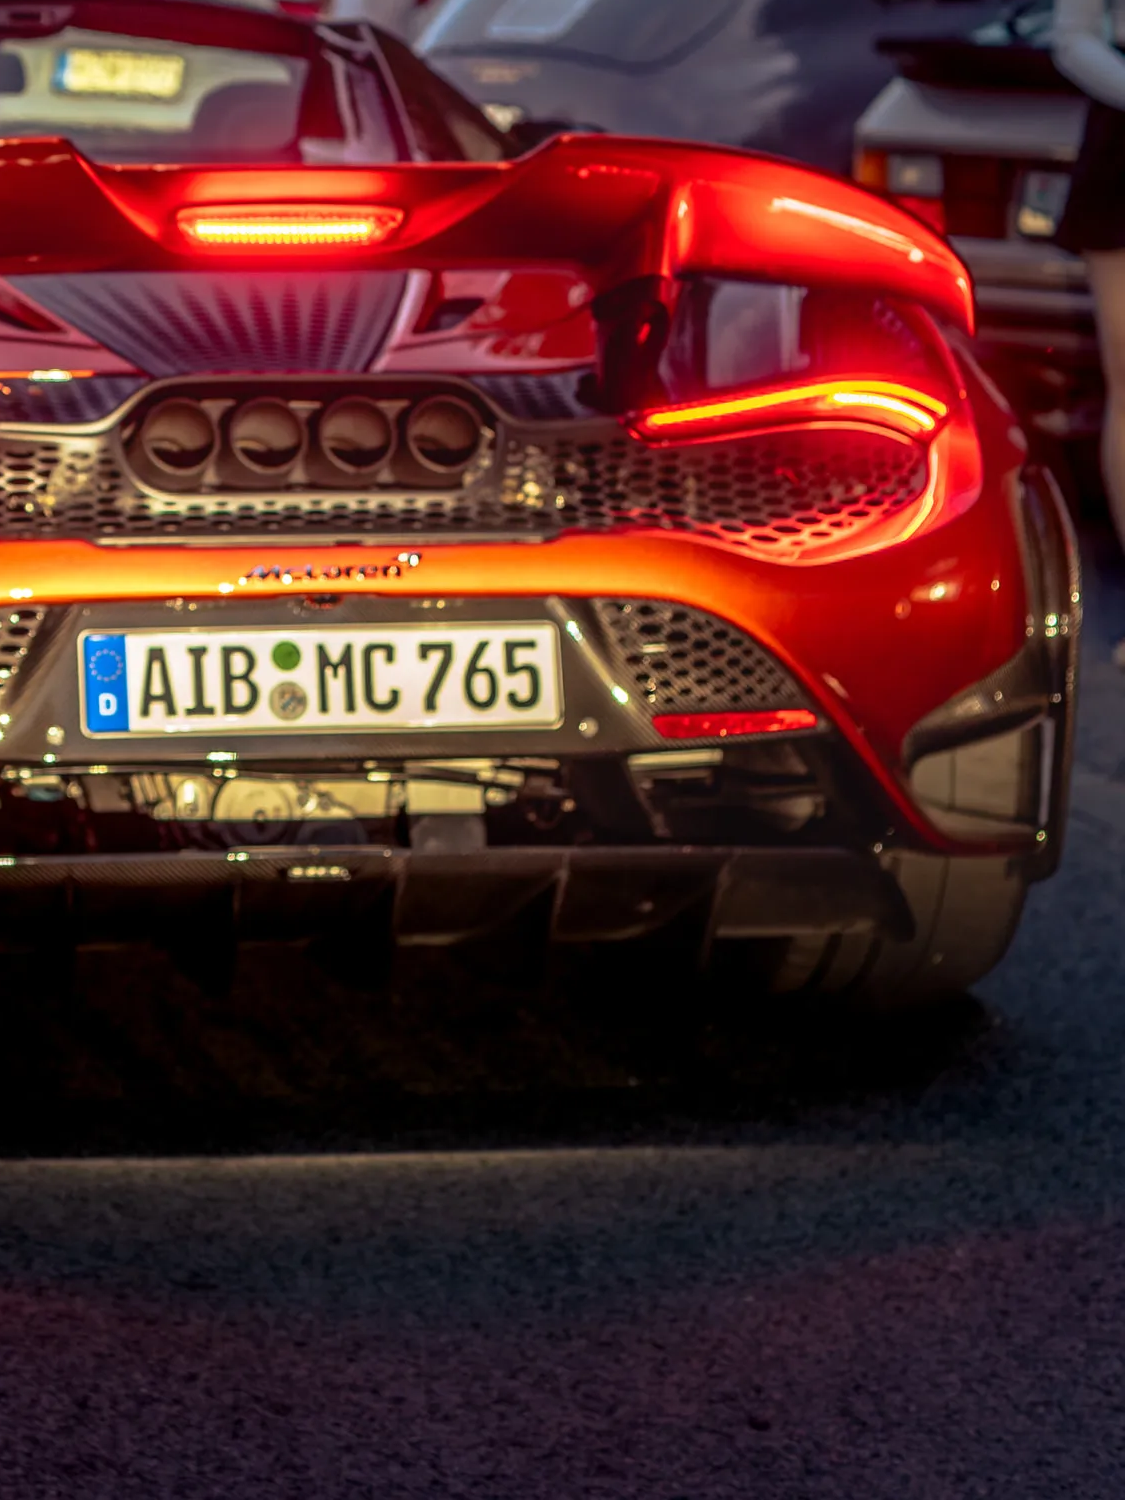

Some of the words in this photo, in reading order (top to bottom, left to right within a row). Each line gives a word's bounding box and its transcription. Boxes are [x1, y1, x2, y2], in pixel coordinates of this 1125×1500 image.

[98, 692, 118, 717] D
[139, 645, 261, 719] AIB
[315, 641, 400, 714] MC
[418, 639, 542, 712] 765
